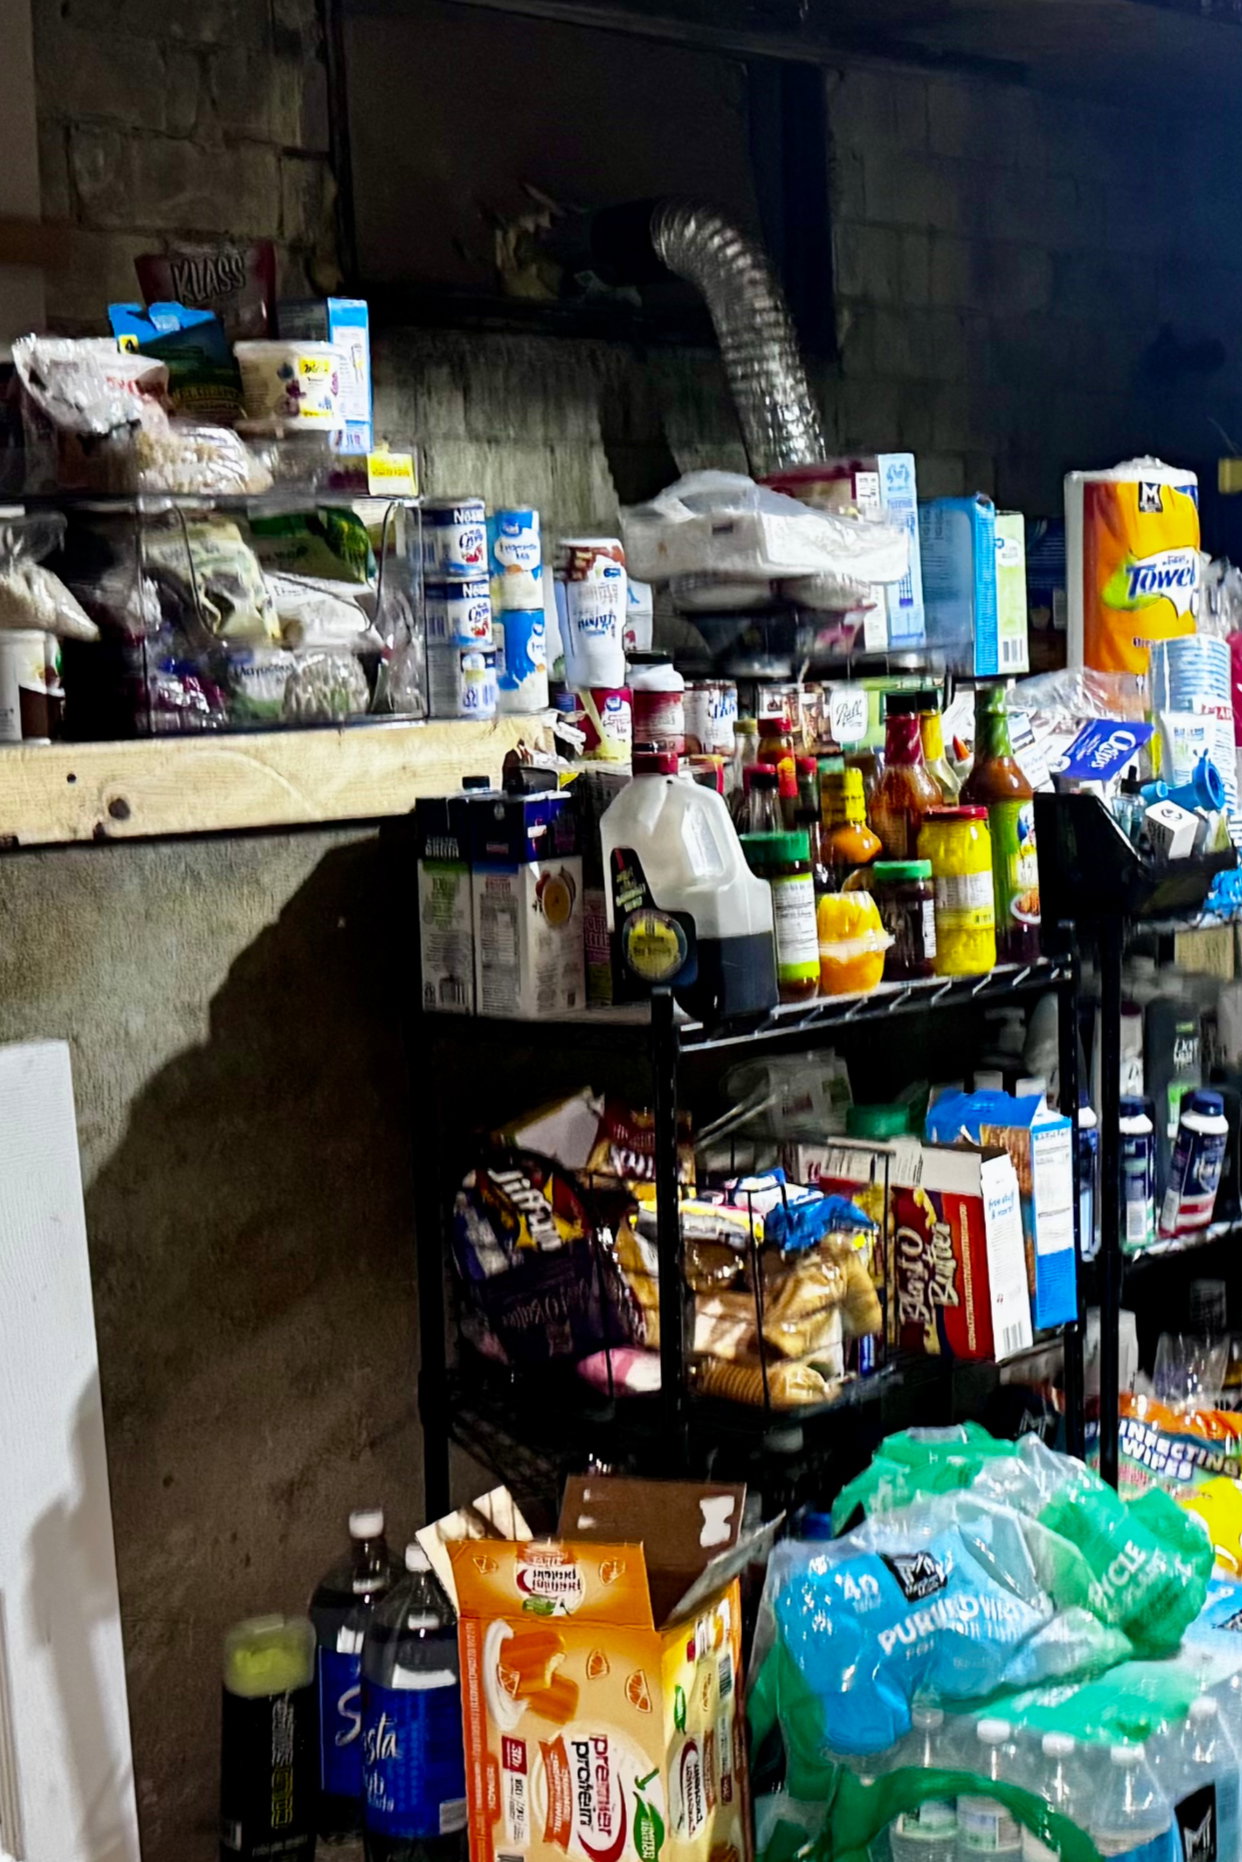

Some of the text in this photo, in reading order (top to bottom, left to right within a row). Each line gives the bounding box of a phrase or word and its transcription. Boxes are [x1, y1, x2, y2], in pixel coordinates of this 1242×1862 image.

[171, 253, 246, 303] KLASS
[570, 1740, 594, 1828] protein
[589, 1733, 613, 1838] premier
